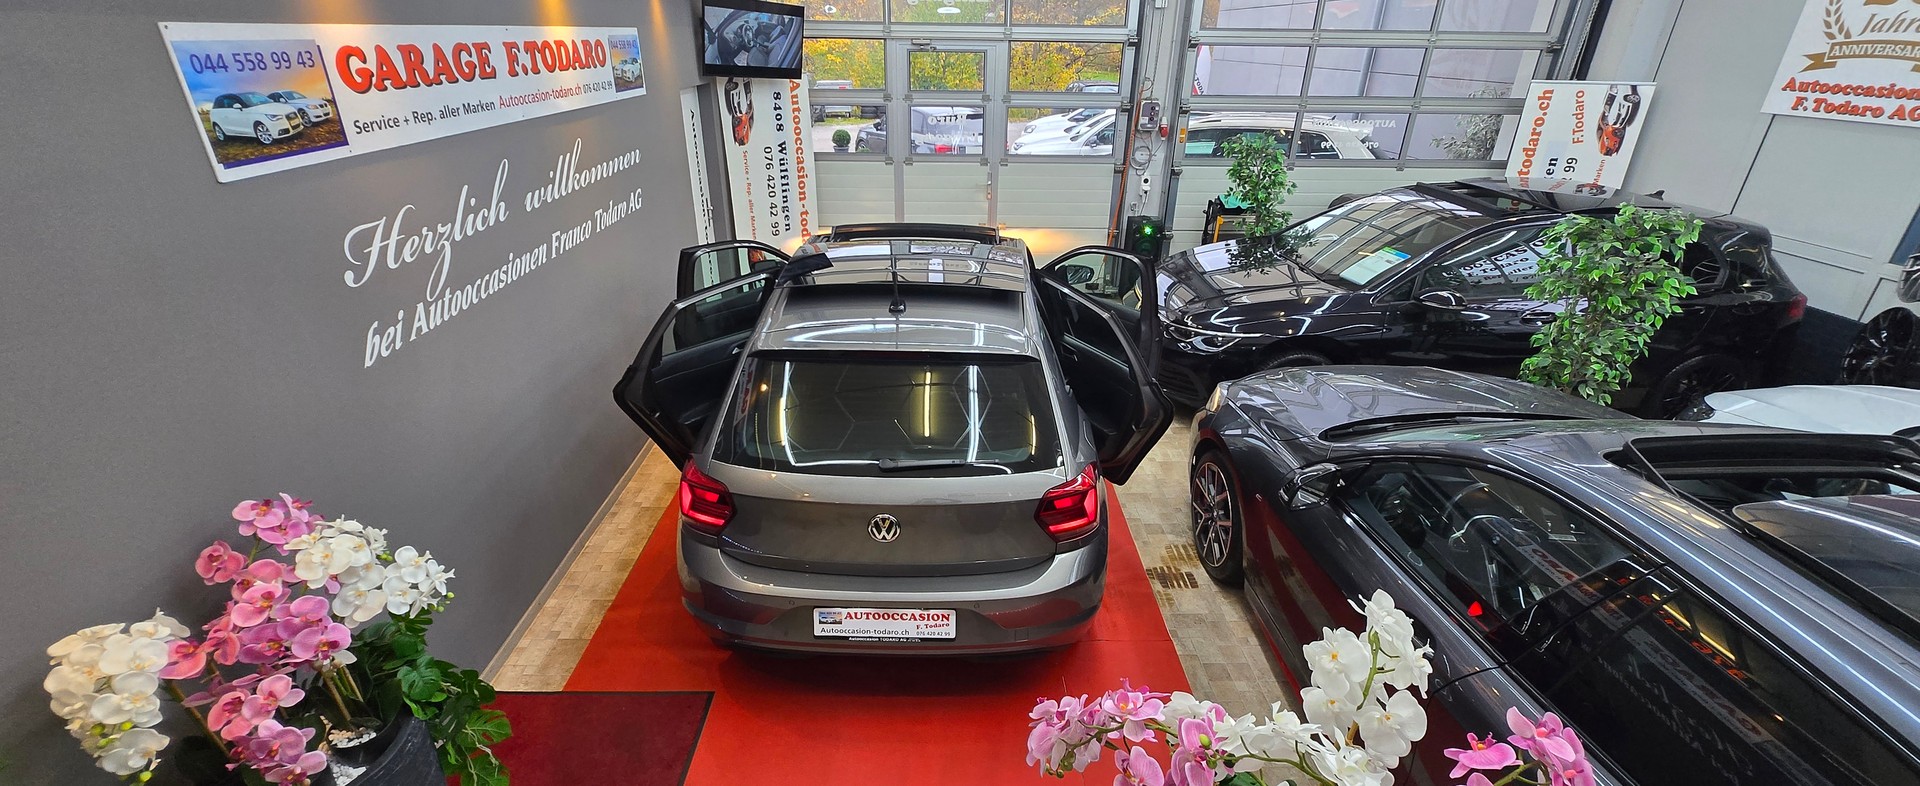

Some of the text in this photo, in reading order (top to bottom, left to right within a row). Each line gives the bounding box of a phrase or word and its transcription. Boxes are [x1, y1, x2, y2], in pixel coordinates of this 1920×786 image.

[189, 50, 316, 74] 044 558 99 43
[335, 41, 497, 95] GARAGE
[353, 80, 613, 135] Service + Rep. aller Marken Autooccasion-todaro.ch 076 420 42 99
[1791, 96, 1920, 122] F. Todaro AG
[773, 91, 791, 232] 8408 Wülflingen
[789, 79, 811, 243] Autooccasion-tod
[763, 146, 780, 237] 076 420 42 99
[343, 138, 641, 301] Herzlich willkommen
[364, 188, 642, 368] bei Autooccasionen Franco Todaro AG
[820, 627, 910, 636] Autooccasion-todaro.ch
[844, 611, 951, 622] AUTOOCCASION
